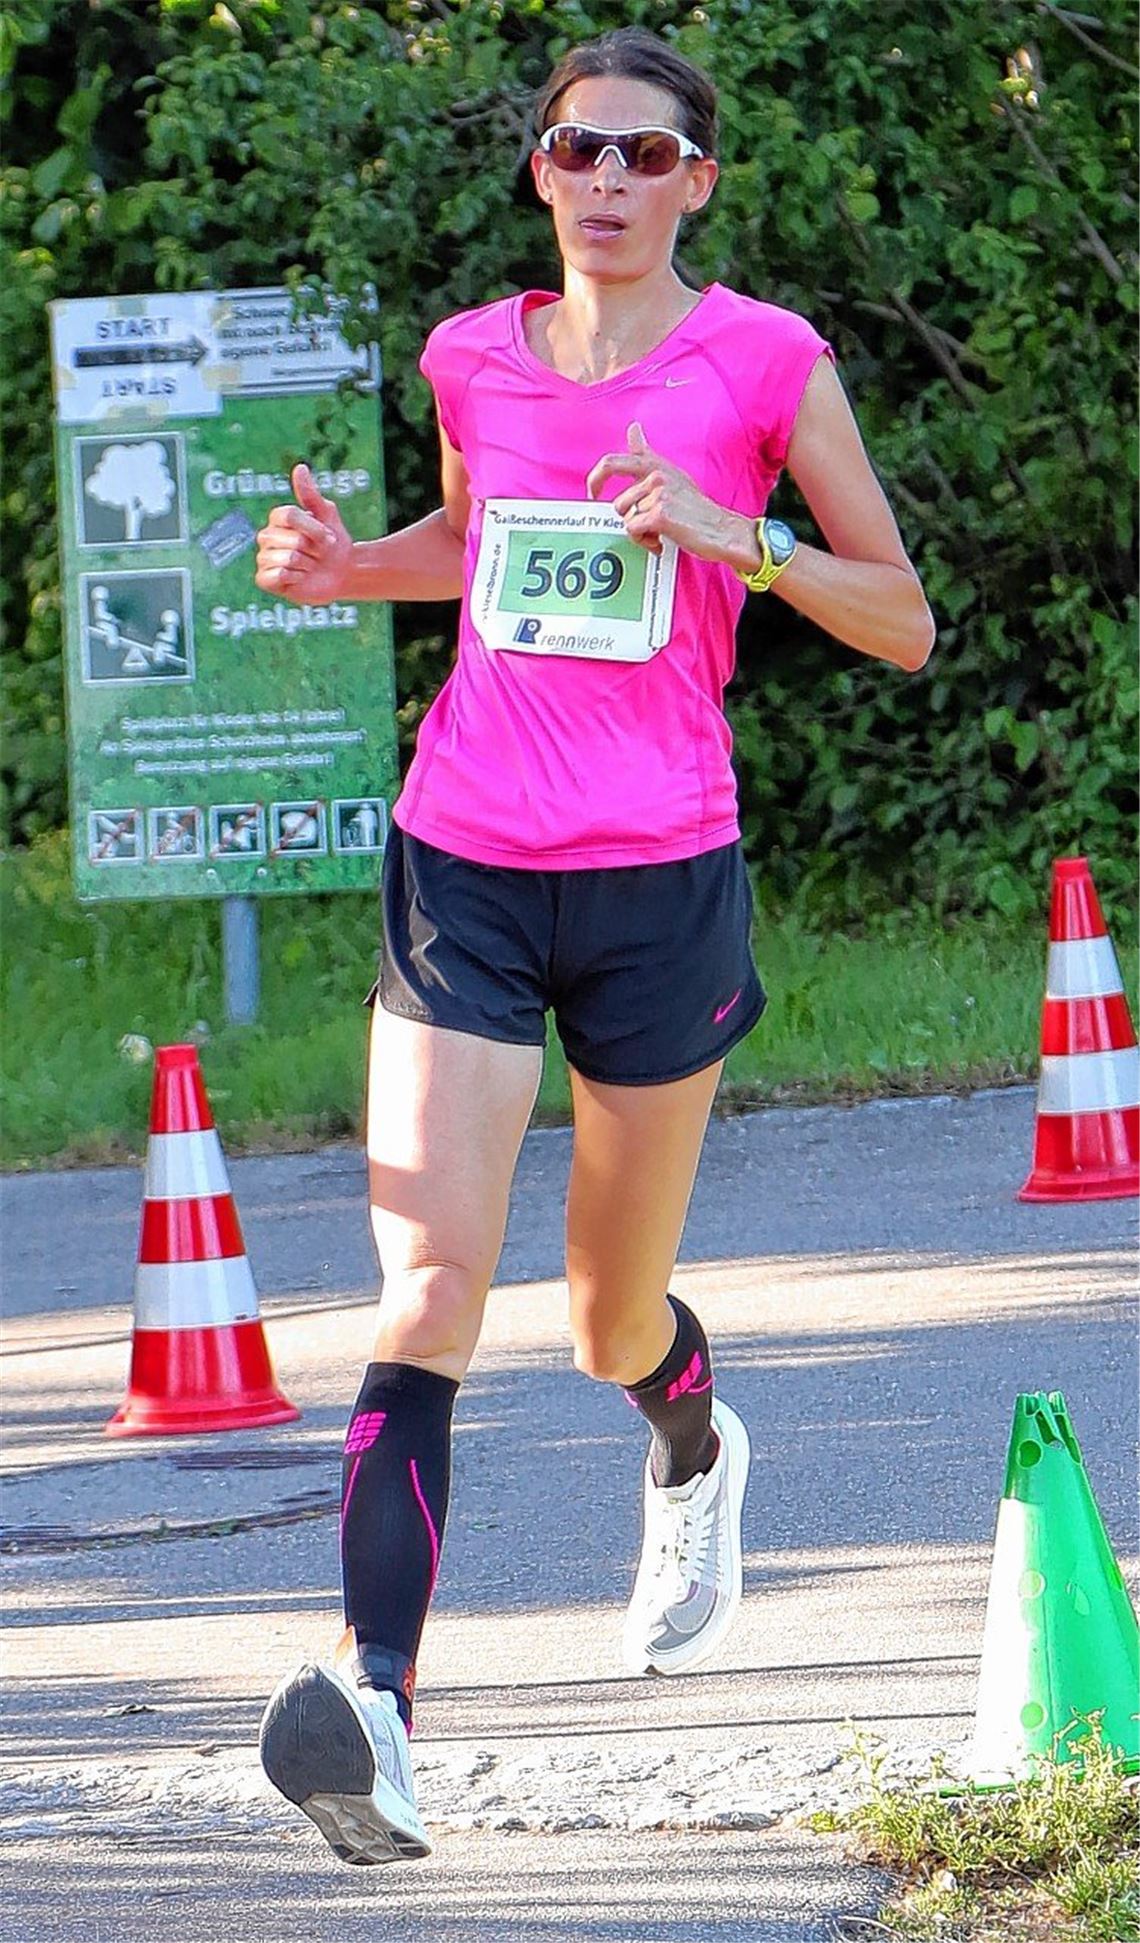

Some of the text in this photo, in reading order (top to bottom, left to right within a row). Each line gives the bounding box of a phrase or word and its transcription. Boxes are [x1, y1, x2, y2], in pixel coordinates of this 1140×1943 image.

[96, 317, 171, 339] START
[204, 468, 371, 497] Grünaage
[588, 516, 601, 528] TV
[603, 517, 625, 529] Kies
[521, 549, 624, 600] 569
[210, 603, 359, 637] Spielplatz
[541, 633, 615, 650] rennwerk
